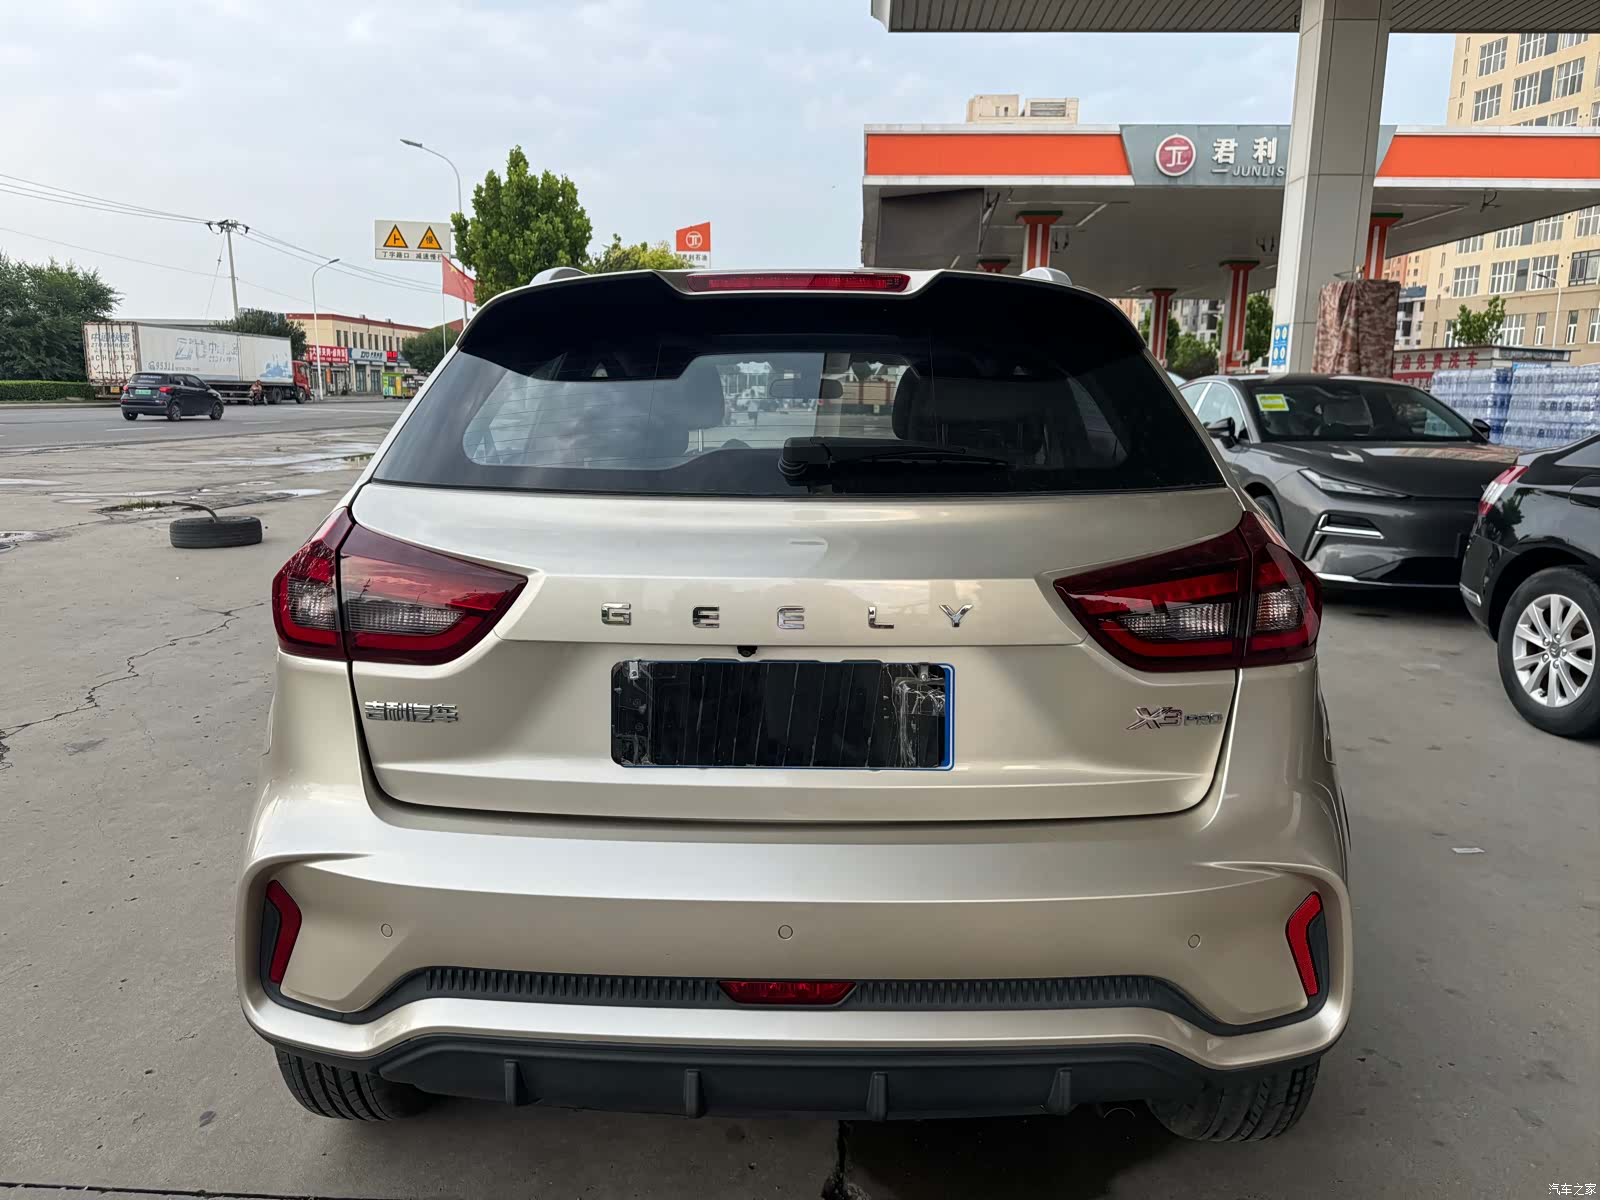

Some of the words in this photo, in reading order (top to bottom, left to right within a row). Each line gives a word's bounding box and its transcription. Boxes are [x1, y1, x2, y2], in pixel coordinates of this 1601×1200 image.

[1212, 137, 1277, 164] 君利
[1393, 350, 1478, 370] 油免费洗车
[600, 602, 974, 630] GEELY
[364, 701, 459, 723] 吉利汽车
